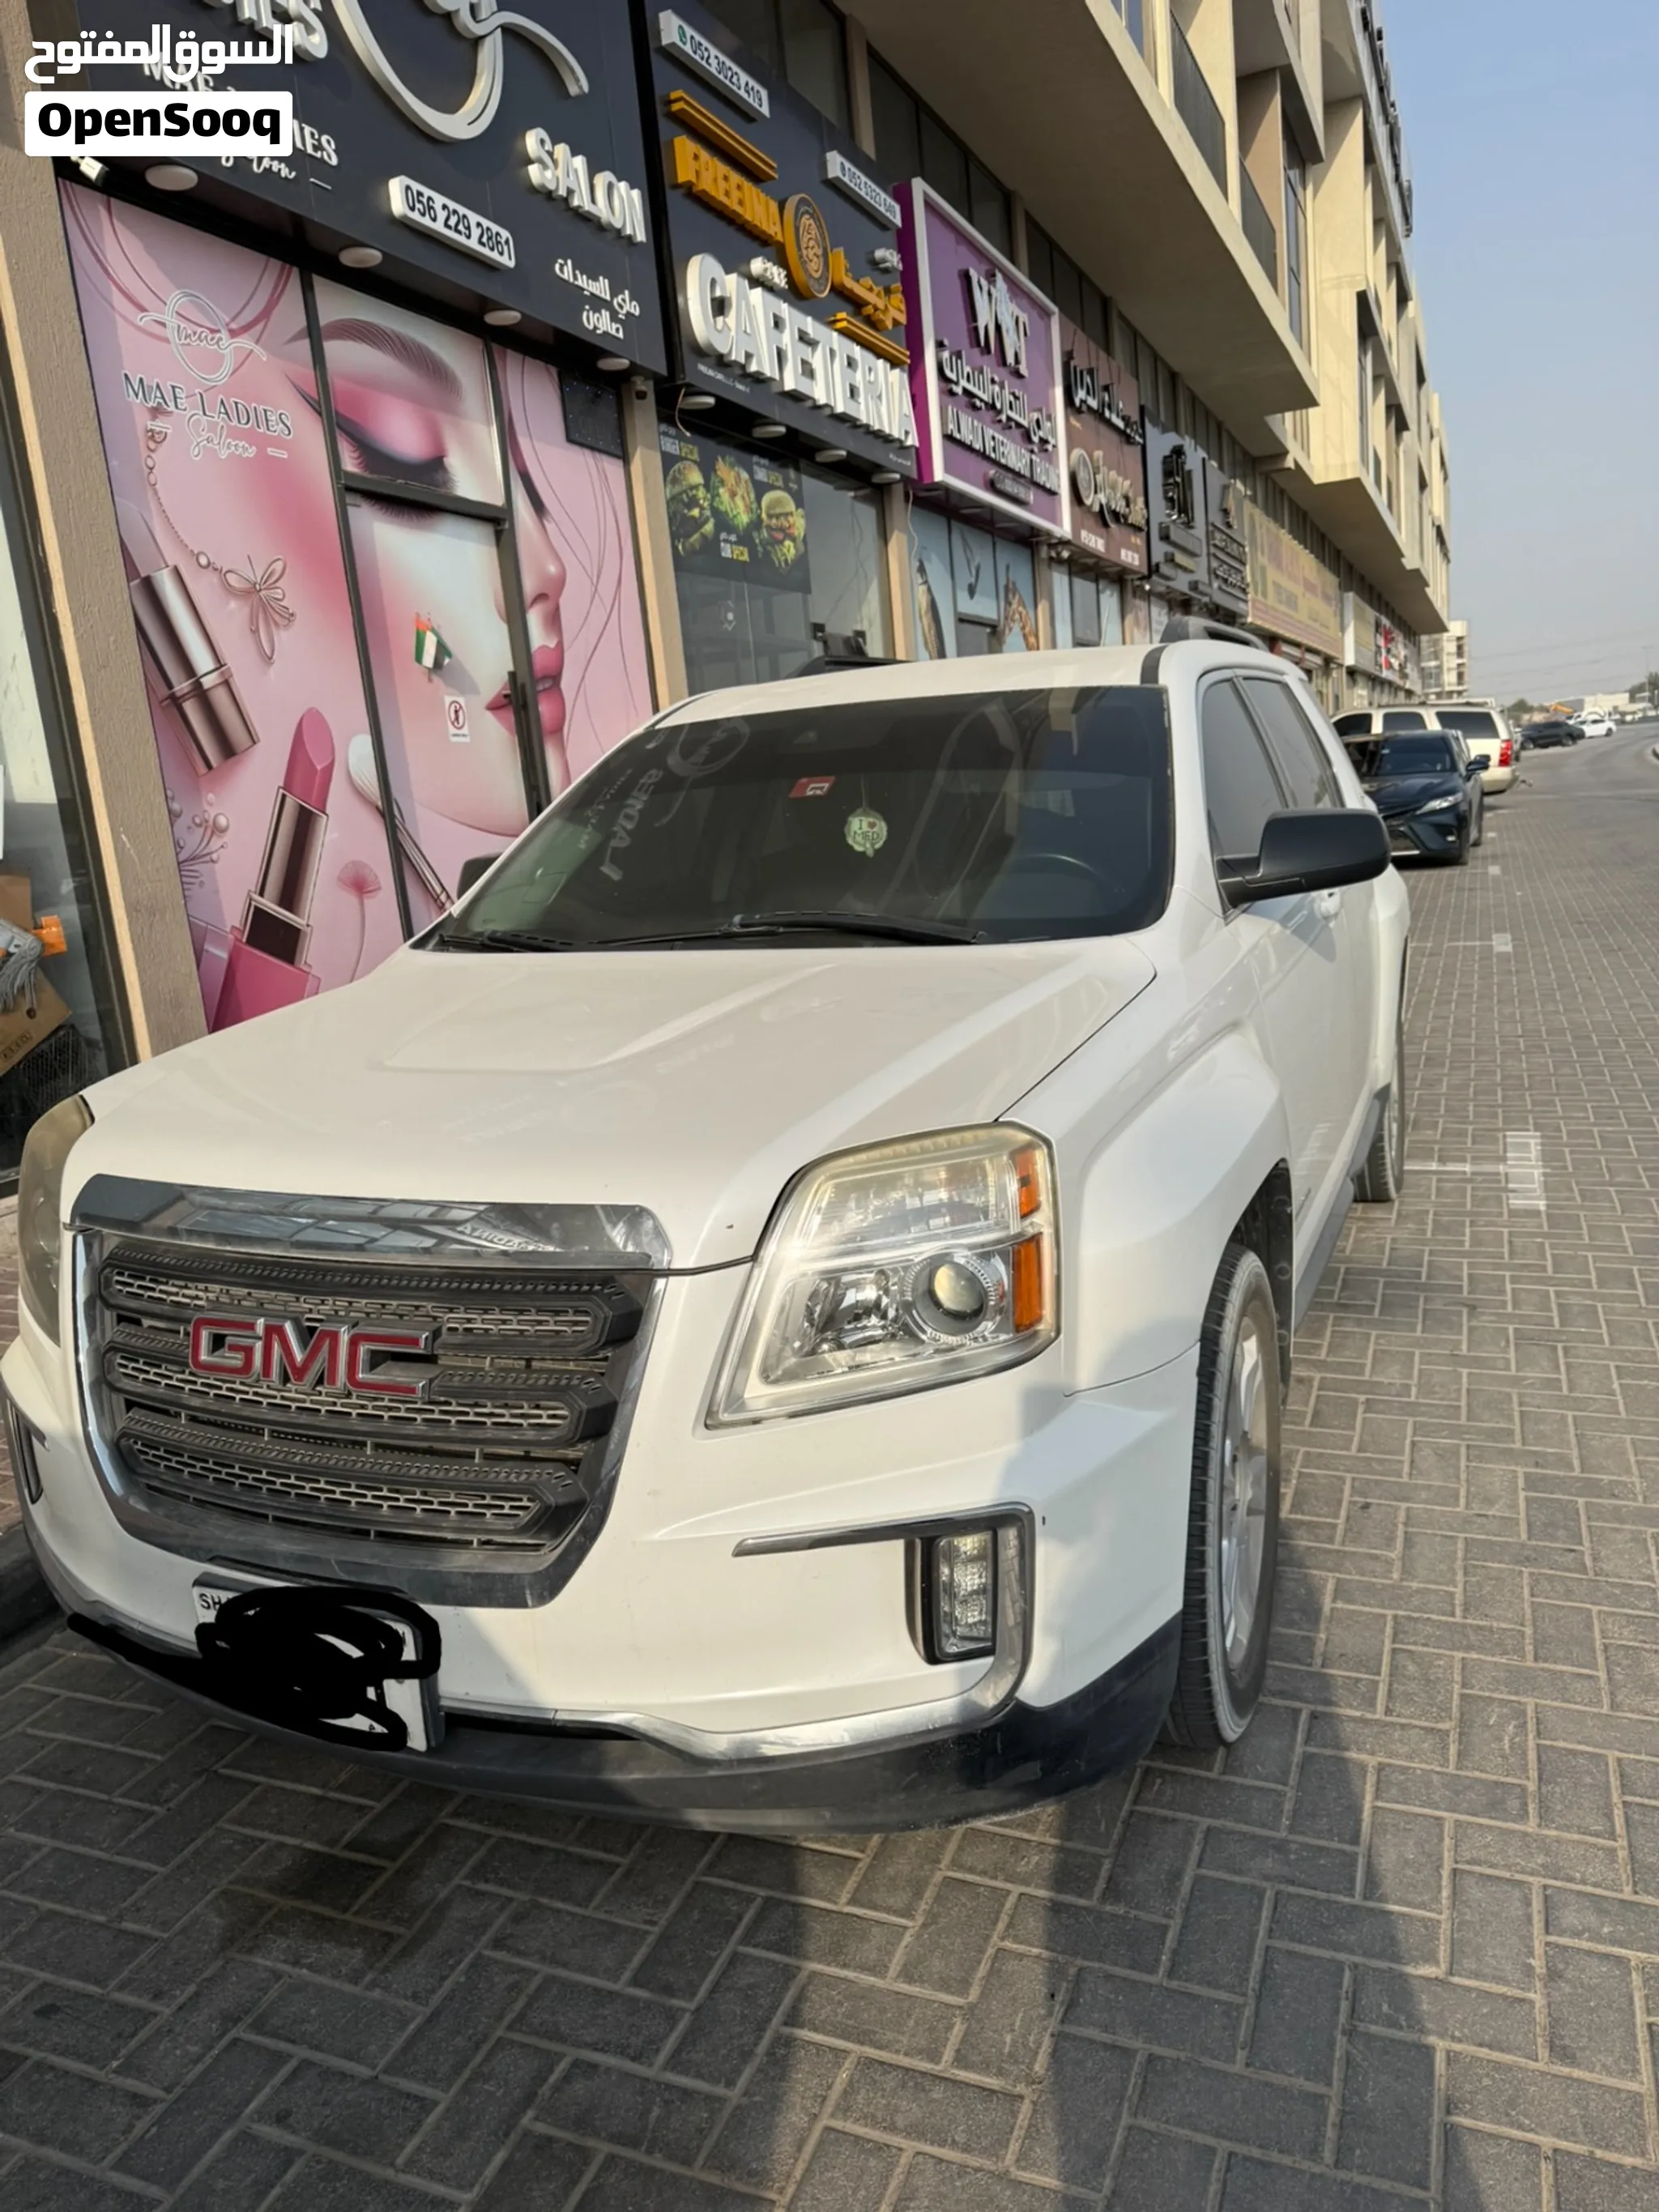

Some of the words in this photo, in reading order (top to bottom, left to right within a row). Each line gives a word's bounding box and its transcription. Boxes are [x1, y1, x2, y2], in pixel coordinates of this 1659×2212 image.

[689, 35, 712, 66] 052
[714, 54, 741, 90] 3023
[744, 80, 763, 108] 419
[525, 126, 646, 244] SALON
[403, 183, 437, 223] 056
[441, 203, 472, 241] 229
[476, 220, 513, 262] 2861
[554, 258, 611, 302] للسيدات
[612, 288, 640, 319] ماي
[582, 305, 625, 339] صالون
[686, 252, 919, 447] CAFETERIA
[122, 370, 188, 414] MAE
[196, 390, 292, 440] LADIES
[948, 404, 983, 453] ALWADI
[189, 1311, 441, 1401] GMC
